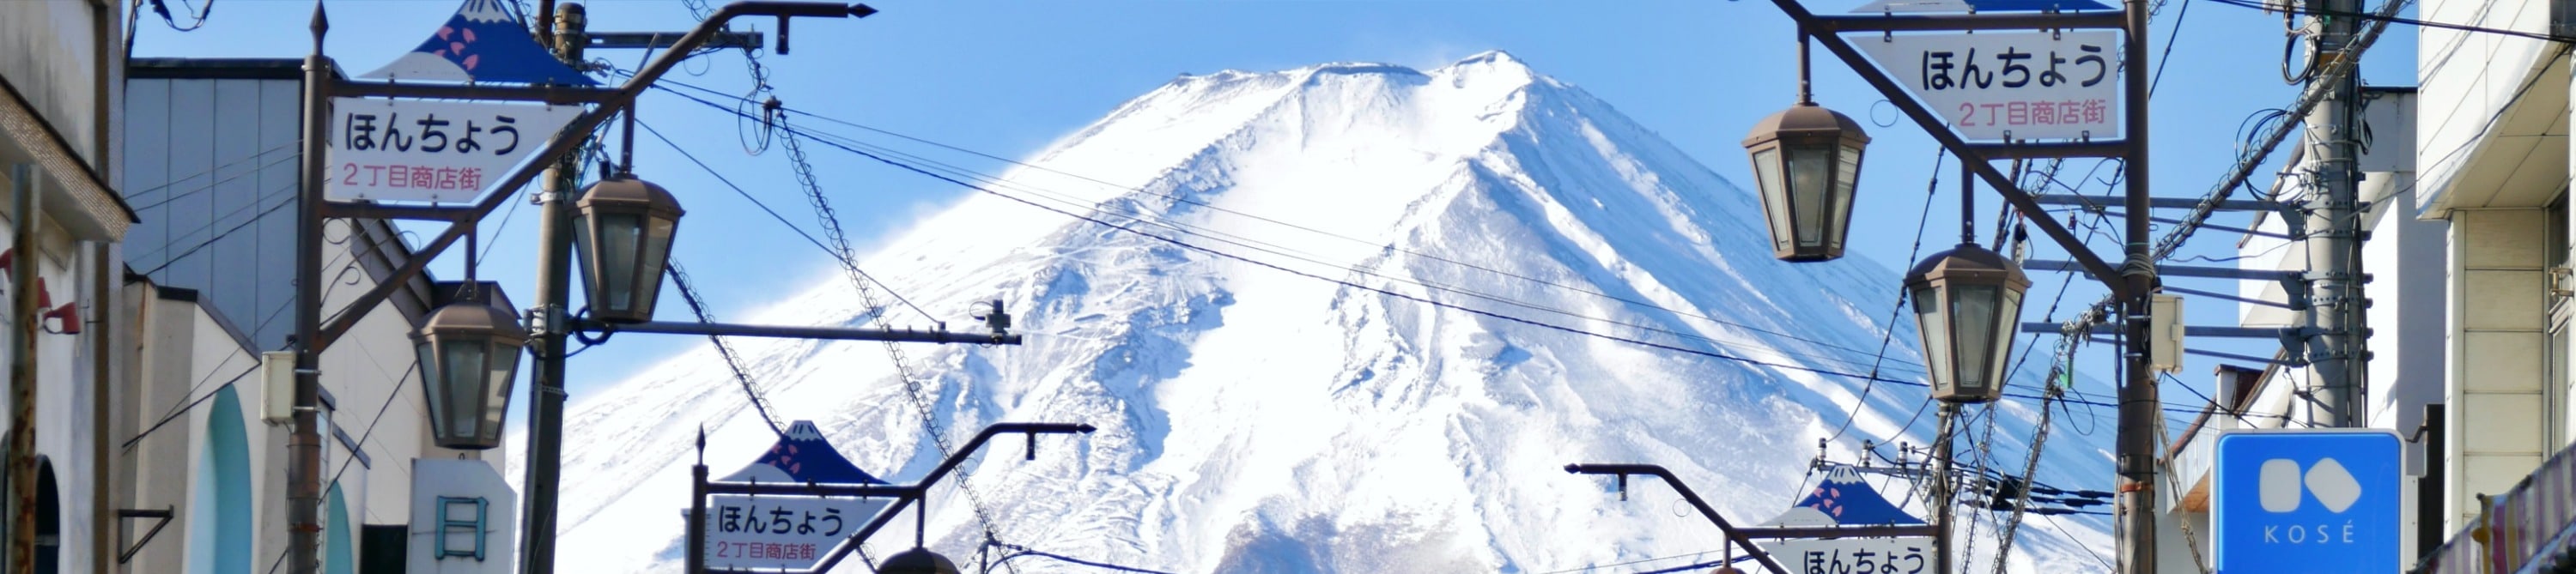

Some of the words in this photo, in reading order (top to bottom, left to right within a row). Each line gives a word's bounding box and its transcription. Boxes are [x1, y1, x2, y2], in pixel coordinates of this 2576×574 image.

[1922, 44, 2106, 90] ほんちょう
[1959, 99, 2106, 127] 2丁目商店街
[345, 112, 519, 156] ほんちょう
[343, 162, 482, 191] 2丁目商店街
[718, 505, 843, 536] ほんちょう
[2264, 519, 2354, 544] KOSÉ
[716, 541, 816, 560] 2丁目商店街
[1803, 547, 1924, 574] ほんちょう
